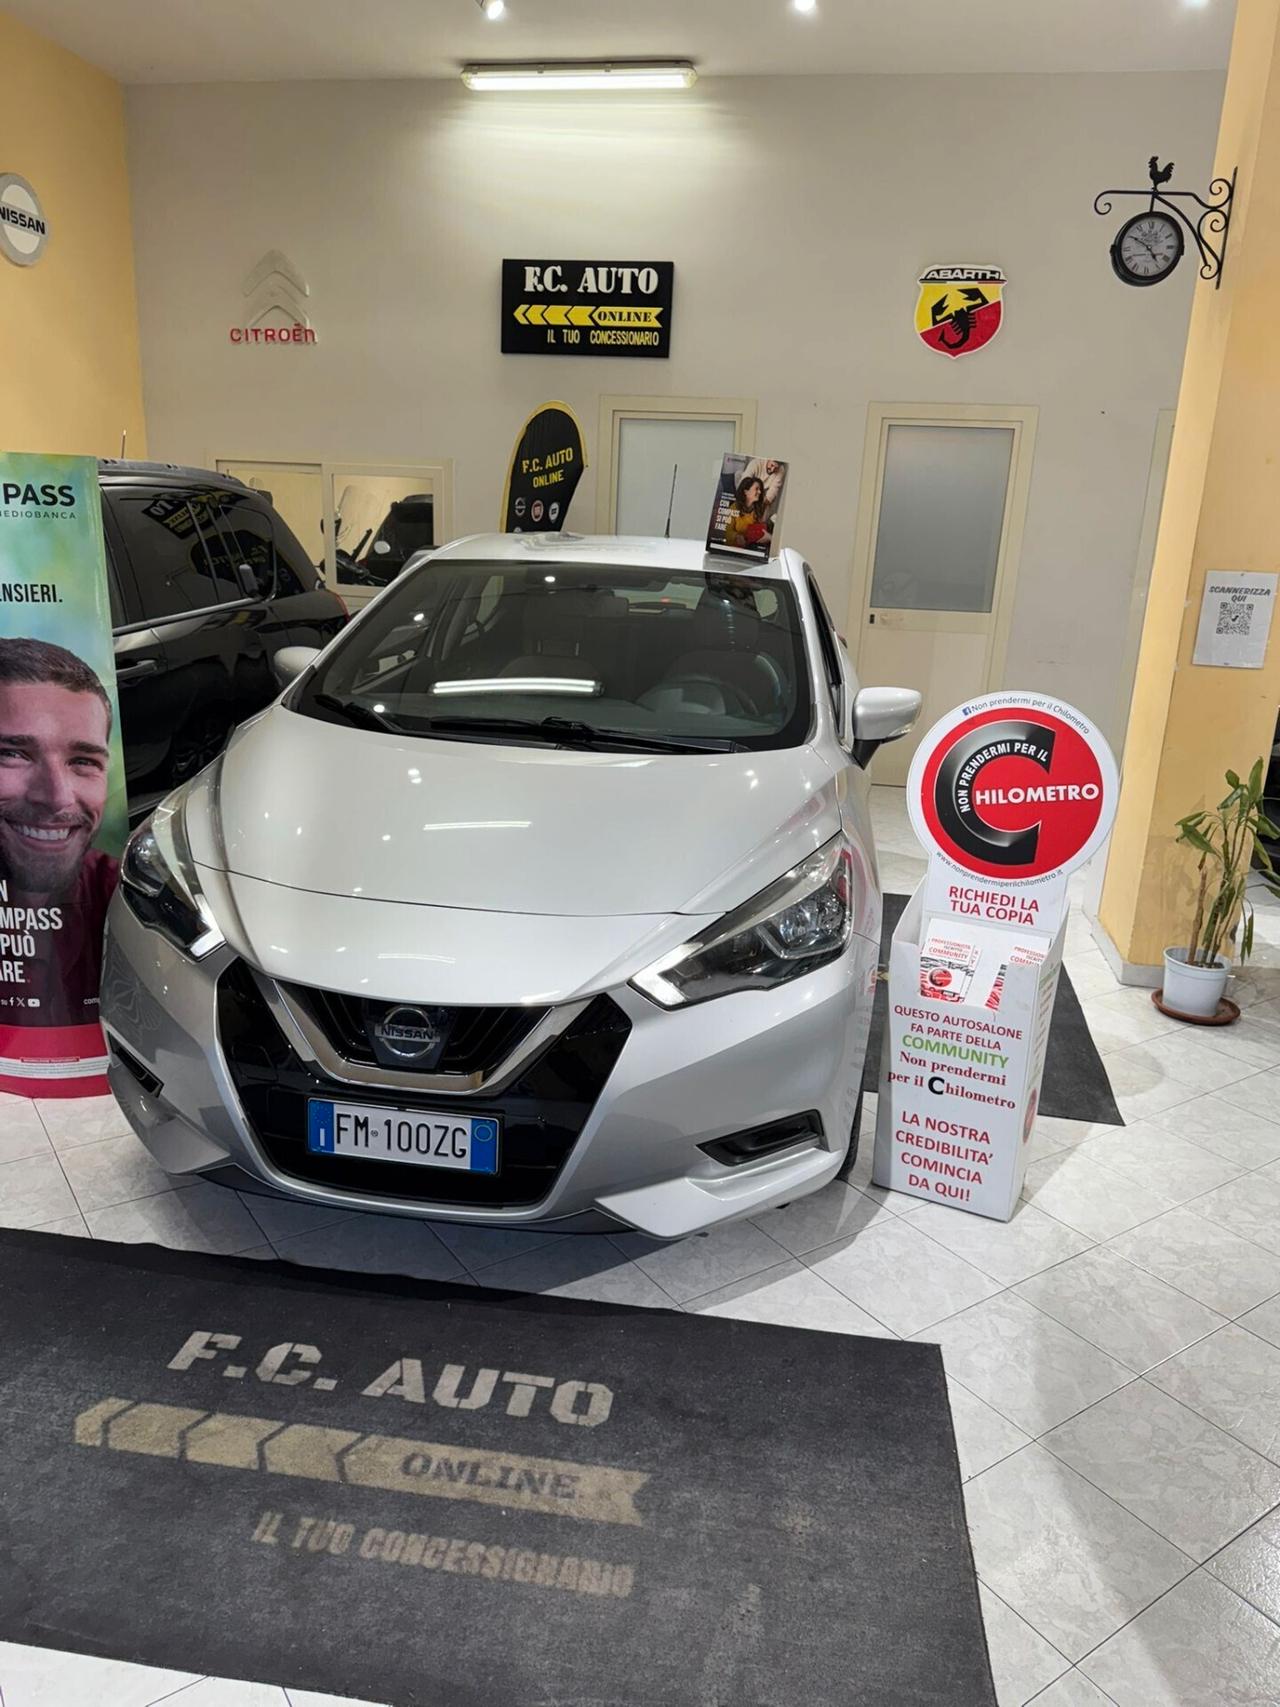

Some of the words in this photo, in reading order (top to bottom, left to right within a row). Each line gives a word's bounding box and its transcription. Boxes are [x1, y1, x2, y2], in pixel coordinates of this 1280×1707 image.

[0, 206, 45, 234] NISSAN
[524, 266, 568, 292] F.C.
[577, 267, 659, 294] AUTO
[926, 269, 999, 279] ABARTH
[598, 311, 652, 323] ONLINE
[547, 329, 556, 343] IL
[563, 330, 580, 344] TUO
[590, 331, 659, 346] CONCESSIONARIO
[522, 458, 543, 473] F.C.
[545, 447, 573, 469] AUTO
[533, 469, 564, 488] ONLINE
[0, 510, 77, 519] EDIOBANCA
[0, 583, 63, 602] NSIERI.
[1208, 586, 1271, 596] SCANNERIZZA
[971, 702, 988, 713] Non
[989, 697, 1031, 706] prendermi
[1032, 698, 1047, 708] per
[1047, 701, 1053, 710] il
[1053, 705, 1090, 735] Chilometro
[1014, 743, 1037, 756] PER
[1037, 748, 1049, 762] IL
[959, 743, 1011, 787] PRENDERMI
[957, 789, 971, 813] NON
[949, 886, 1016, 908] RICHIEDI
[1020, 898, 1040, 912] LA
[950, 900, 981, 916] TUA
[986, 906, 1034, 925] COPIA
[0, 930, 36, 957] PUÒ
[928, 947, 970, 960] COMMUNITY
[382, 1027, 433, 1040] NISSAN
[894, 1005, 940, 1022] QUESTO
[942, 1015, 1023, 1040] AUTOSALONE
[911, 1023, 924, 1034] FA
[927, 1026, 962, 1042] PARTE
[966, 1034, 1002, 1050] DELLA
[902, 1035, 1009, 1068] COMMUNITY
[899, 1051, 927, 1068] Non
[931, 1060, 1007, 1086] prendermi
[887, 1071, 911, 1083] per
[914, 1075, 924, 1087] il
[928, 1076, 1016, 1109] Chilometro
[336, 1113, 369, 1147] FM
[384, 1119, 467, 1158] 100ZG
[902, 1111, 920, 1126] LA
[925, 1117, 990, 1144] NOSTRA
[900, 1151, 983, 1184] COMINCIA
[908, 1174, 930, 1190] DA
[934, 1182, 970, 1201] QUI!
[167, 1330, 338, 1392] F.C.
[361, 1357, 614, 1427] AUTO
[400, 1453, 581, 1500] ONLINE
[250, 1511, 284, 1546] IL
[293, 1516, 355, 1555] TUO
[360, 1526, 636, 1599] CONCESSIONARIO
